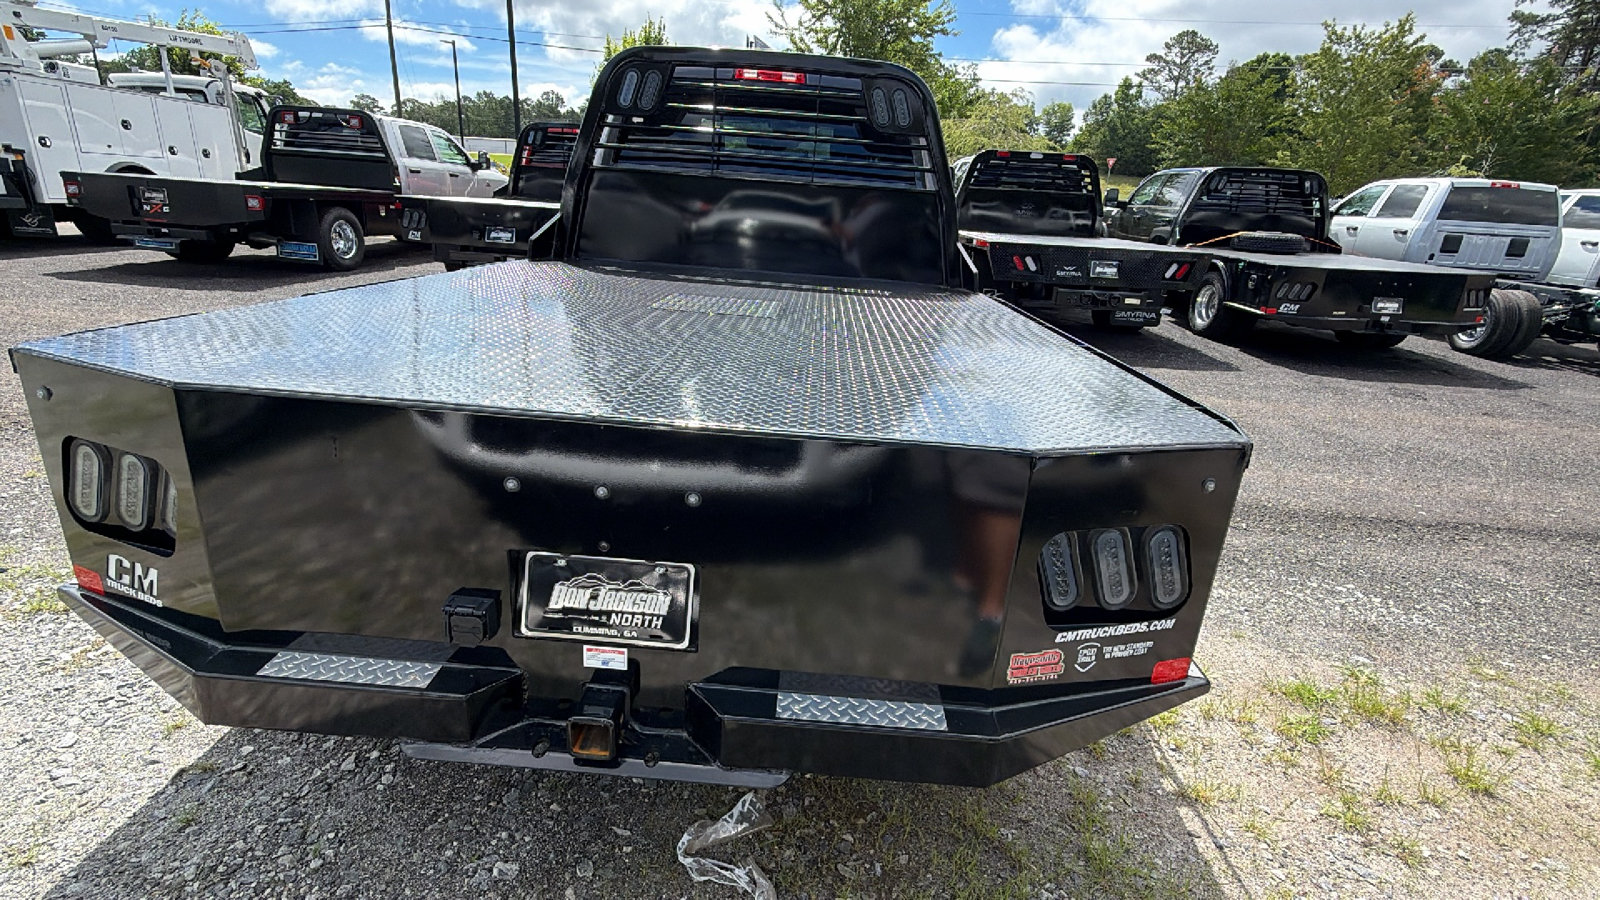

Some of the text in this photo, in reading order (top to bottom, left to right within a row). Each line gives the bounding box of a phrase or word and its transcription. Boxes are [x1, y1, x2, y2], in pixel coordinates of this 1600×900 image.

[1114, 310, 1157, 319] SMYRNA
[108, 554, 158, 596] CM
[106, 578, 163, 607] TRUCK BEDS
[609, 612, 663, 629] NORTH
[1054, 618, 1176, 643] CMTRUCKBEDS.COM
[623, 629, 638, 638] GA
